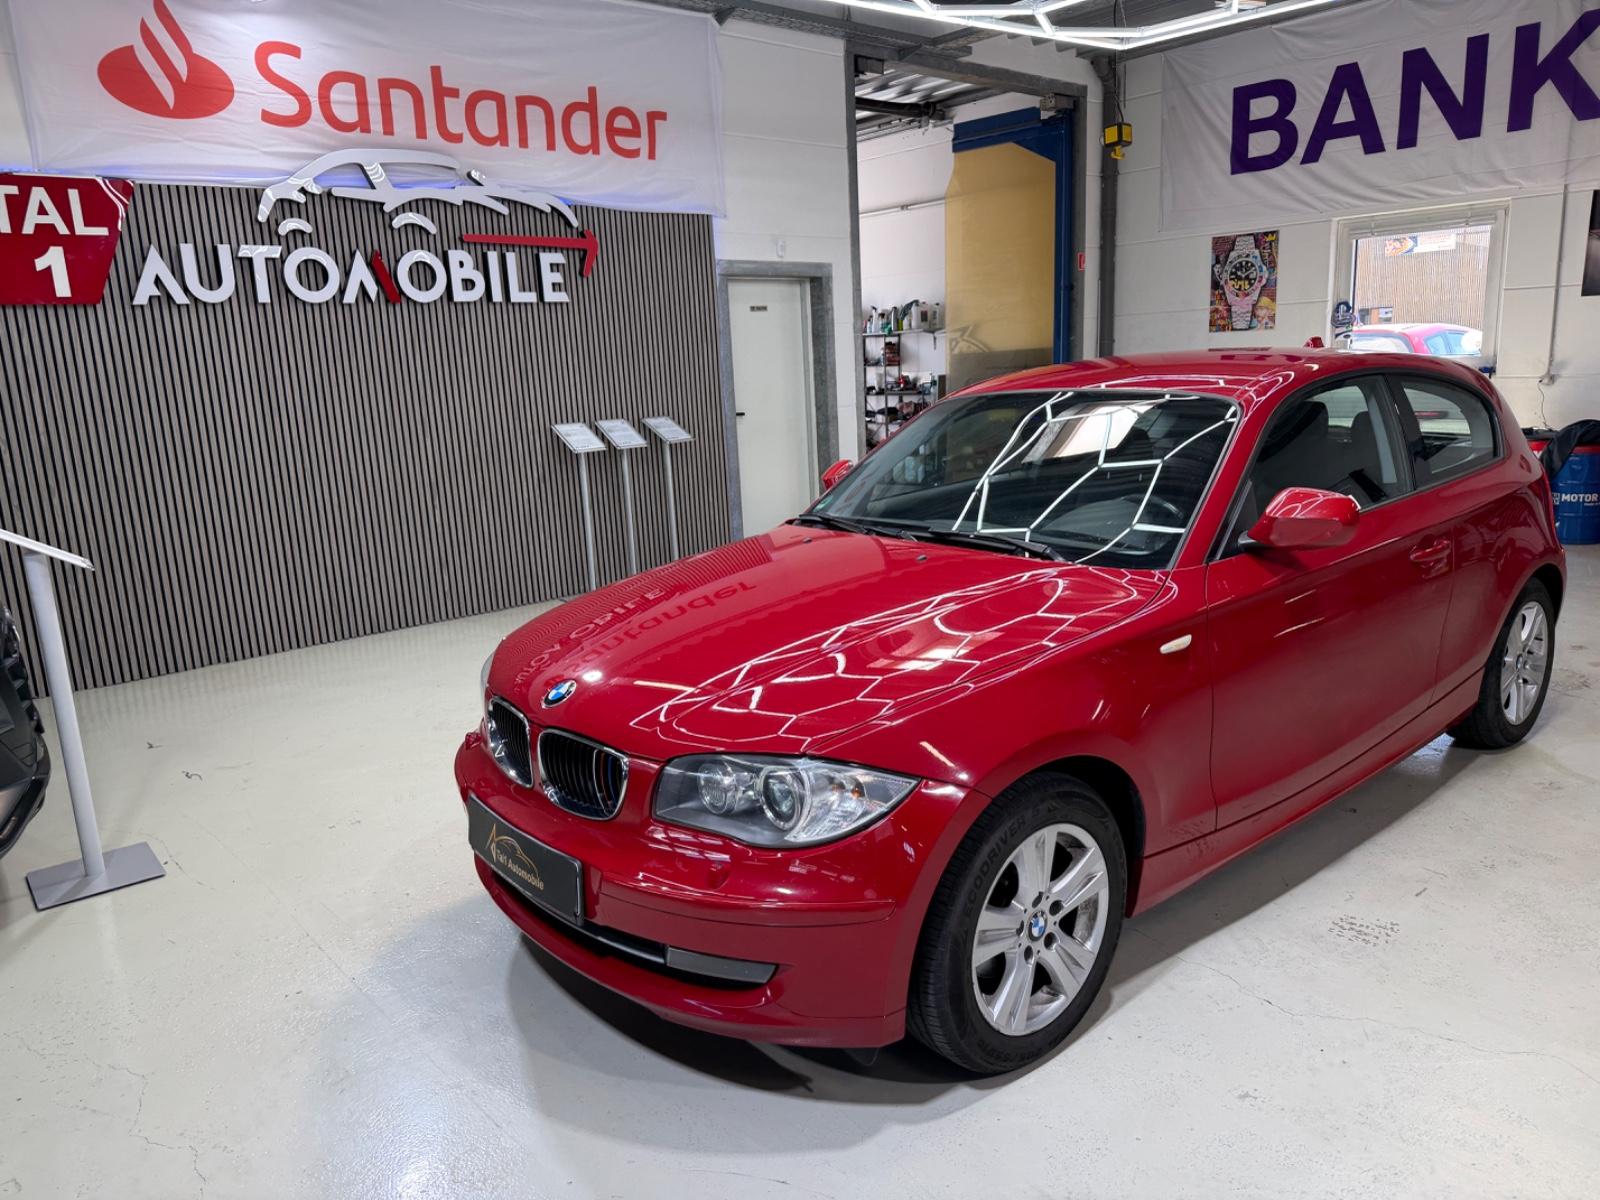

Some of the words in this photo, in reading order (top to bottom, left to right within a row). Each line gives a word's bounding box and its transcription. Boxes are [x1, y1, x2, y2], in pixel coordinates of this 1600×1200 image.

[254, 40, 668, 161] Santander
[1230, 8, 1600, 175] BANK
[34, 245, 72, 298] 1
[132, 243, 570, 305] AUTOMOBILE
[1561, 493, 1599, 502] MOTOR
